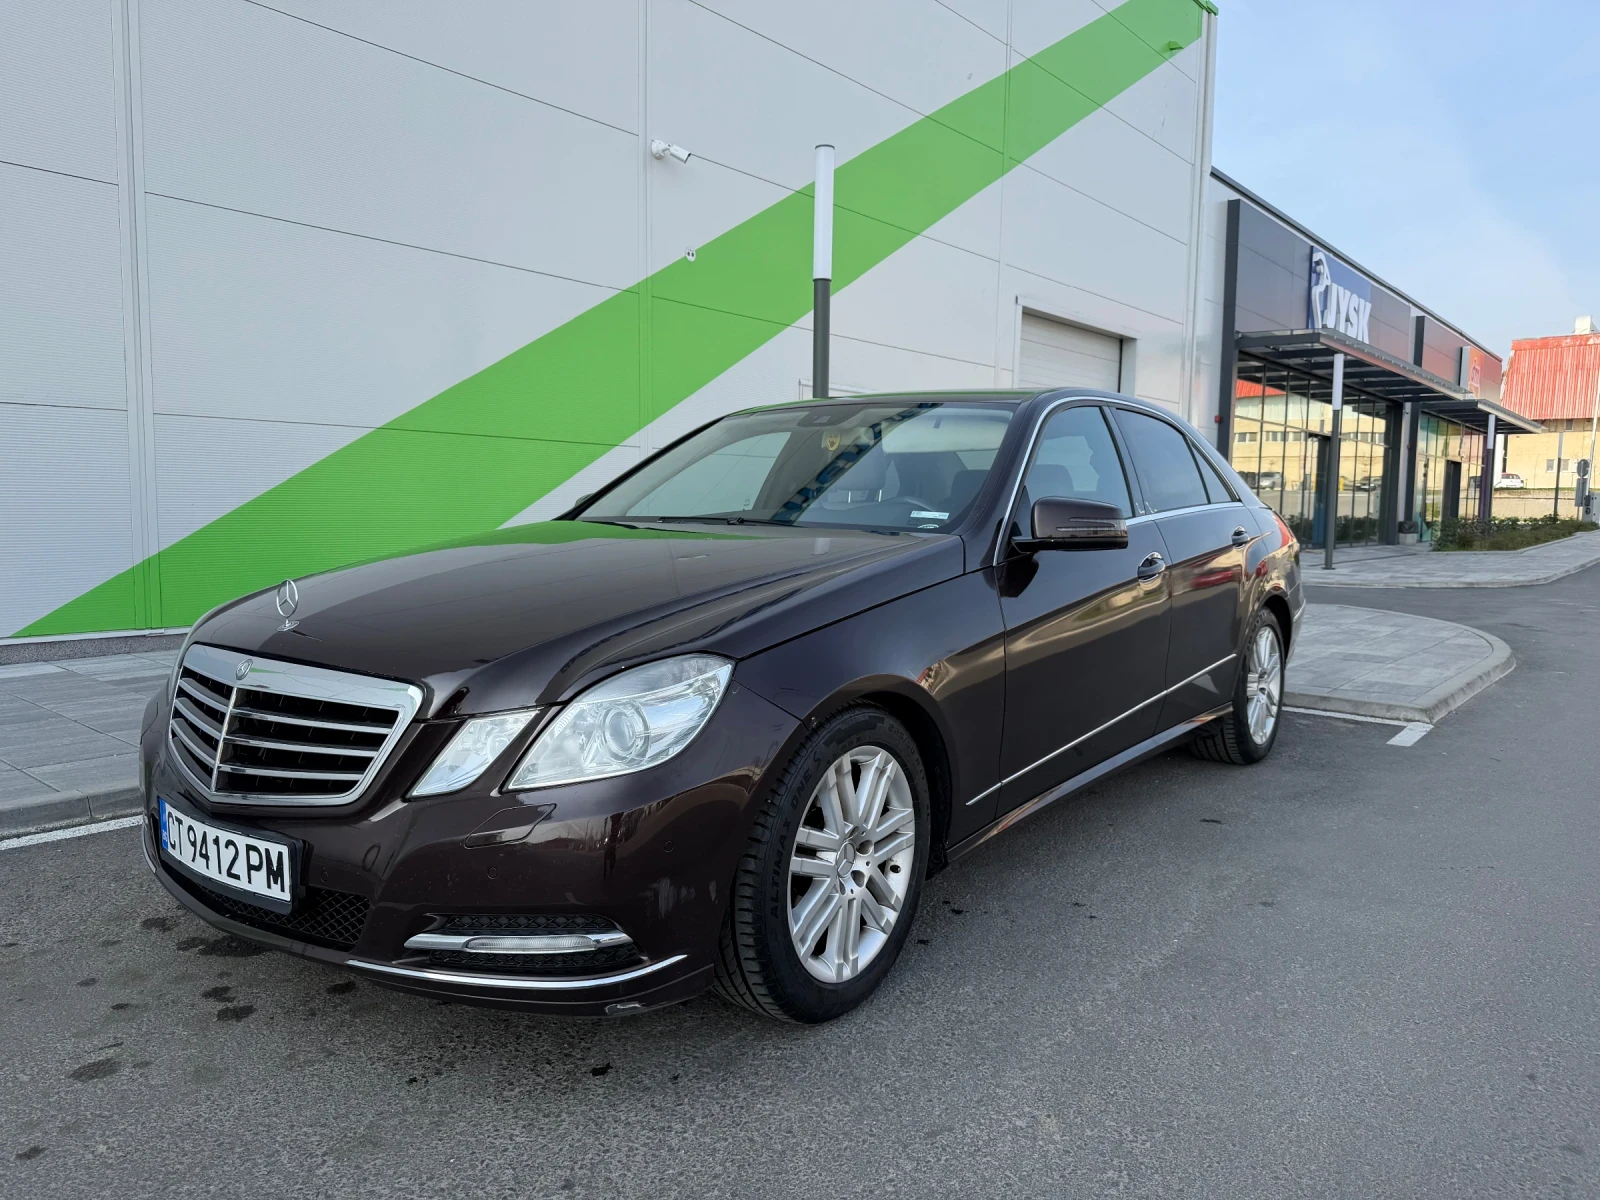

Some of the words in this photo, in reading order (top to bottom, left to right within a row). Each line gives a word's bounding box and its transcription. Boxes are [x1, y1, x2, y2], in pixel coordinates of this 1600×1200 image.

[1325, 283, 1372, 344] JYSK
[770, 819, 792, 920] ALTIMAX
[790, 768, 812, 810] ONE
